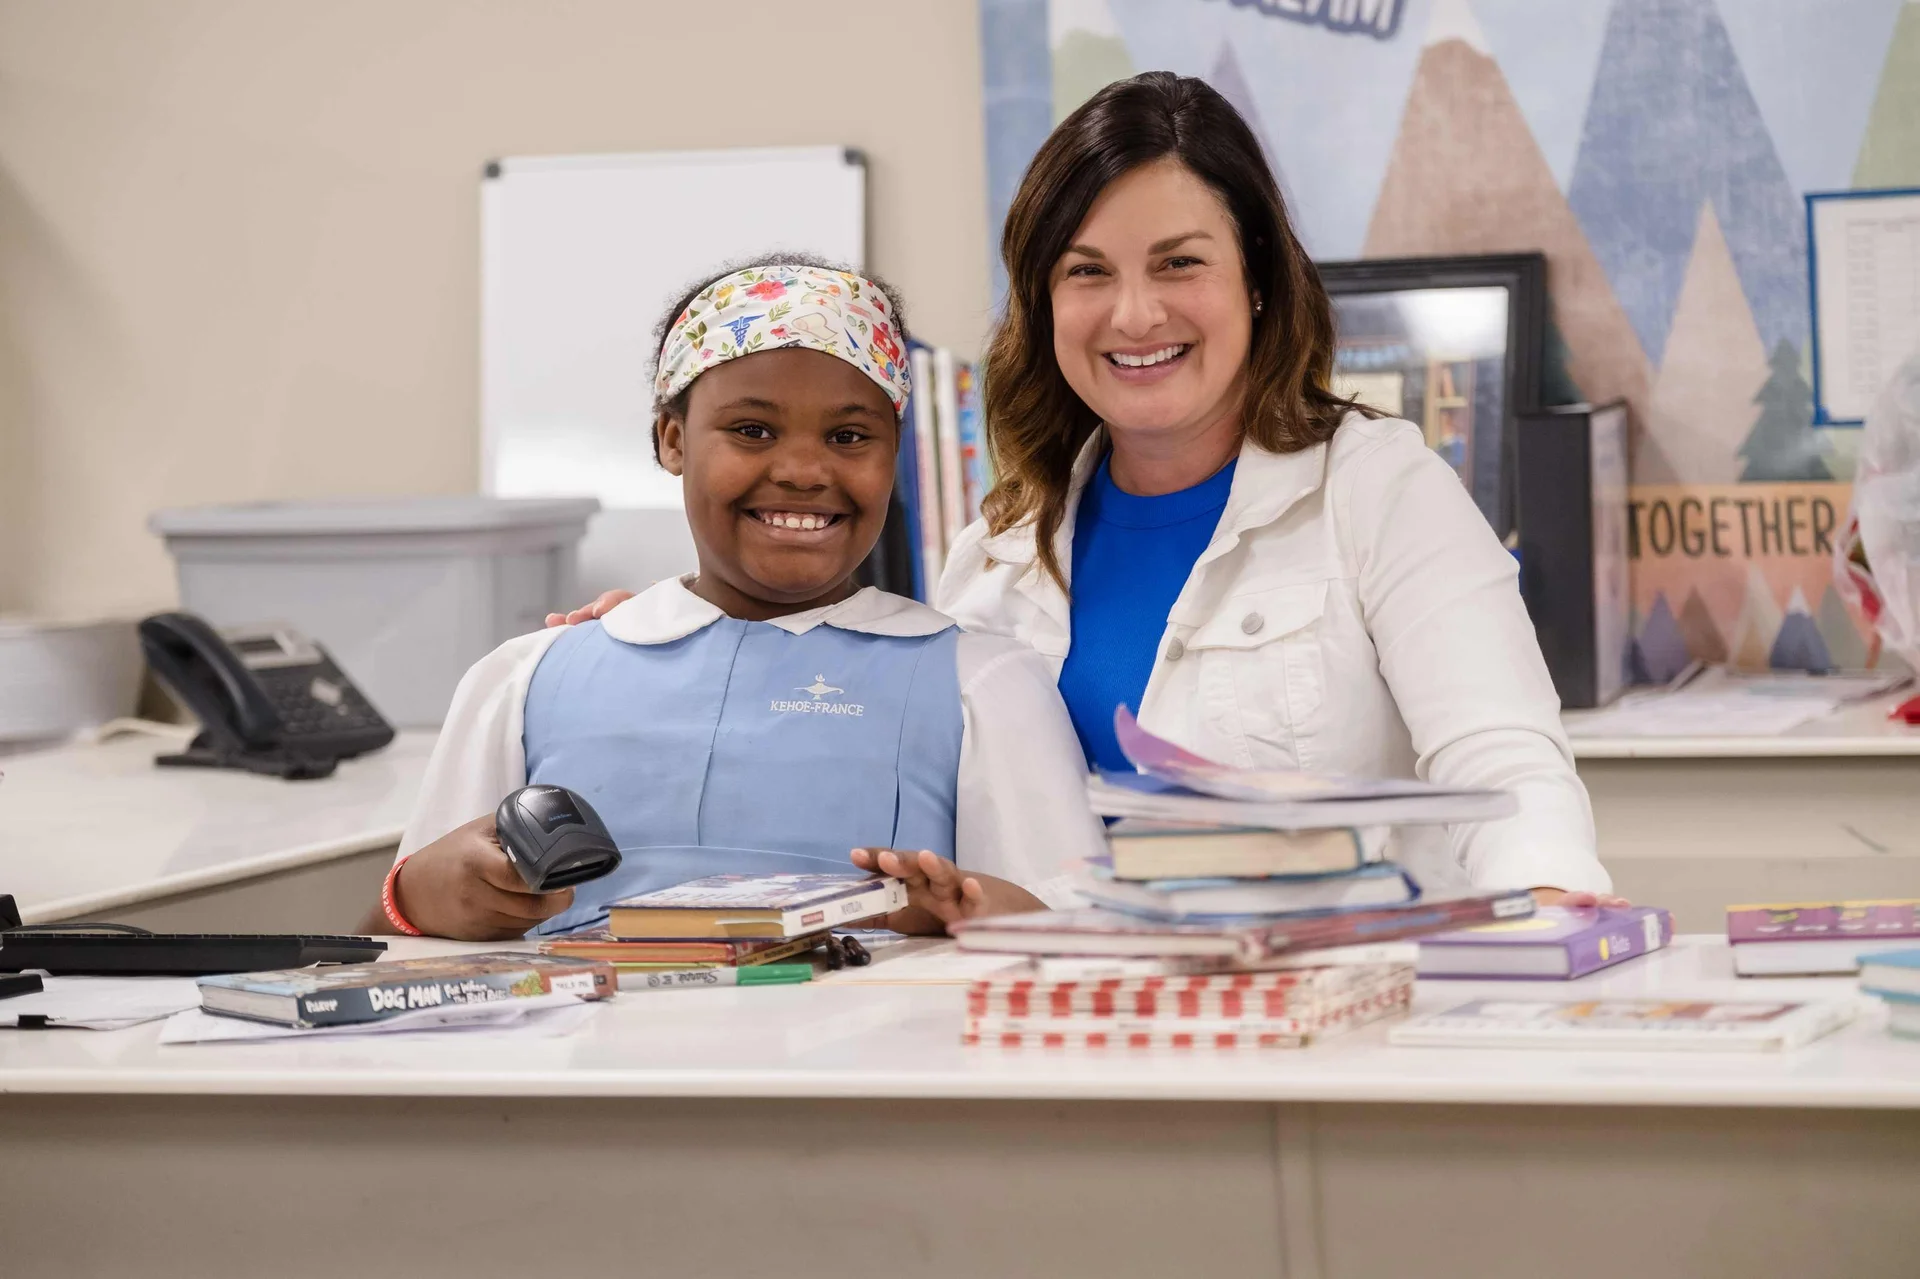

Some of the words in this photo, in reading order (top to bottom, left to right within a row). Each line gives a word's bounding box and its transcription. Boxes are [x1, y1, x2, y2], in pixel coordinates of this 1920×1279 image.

[1627, 496, 1836, 560] TOGETHER
[770, 700, 865, 717] KEHOE-FRANCE
[367, 986, 406, 1012] DOG
[407, 984, 443, 1009] MAN
